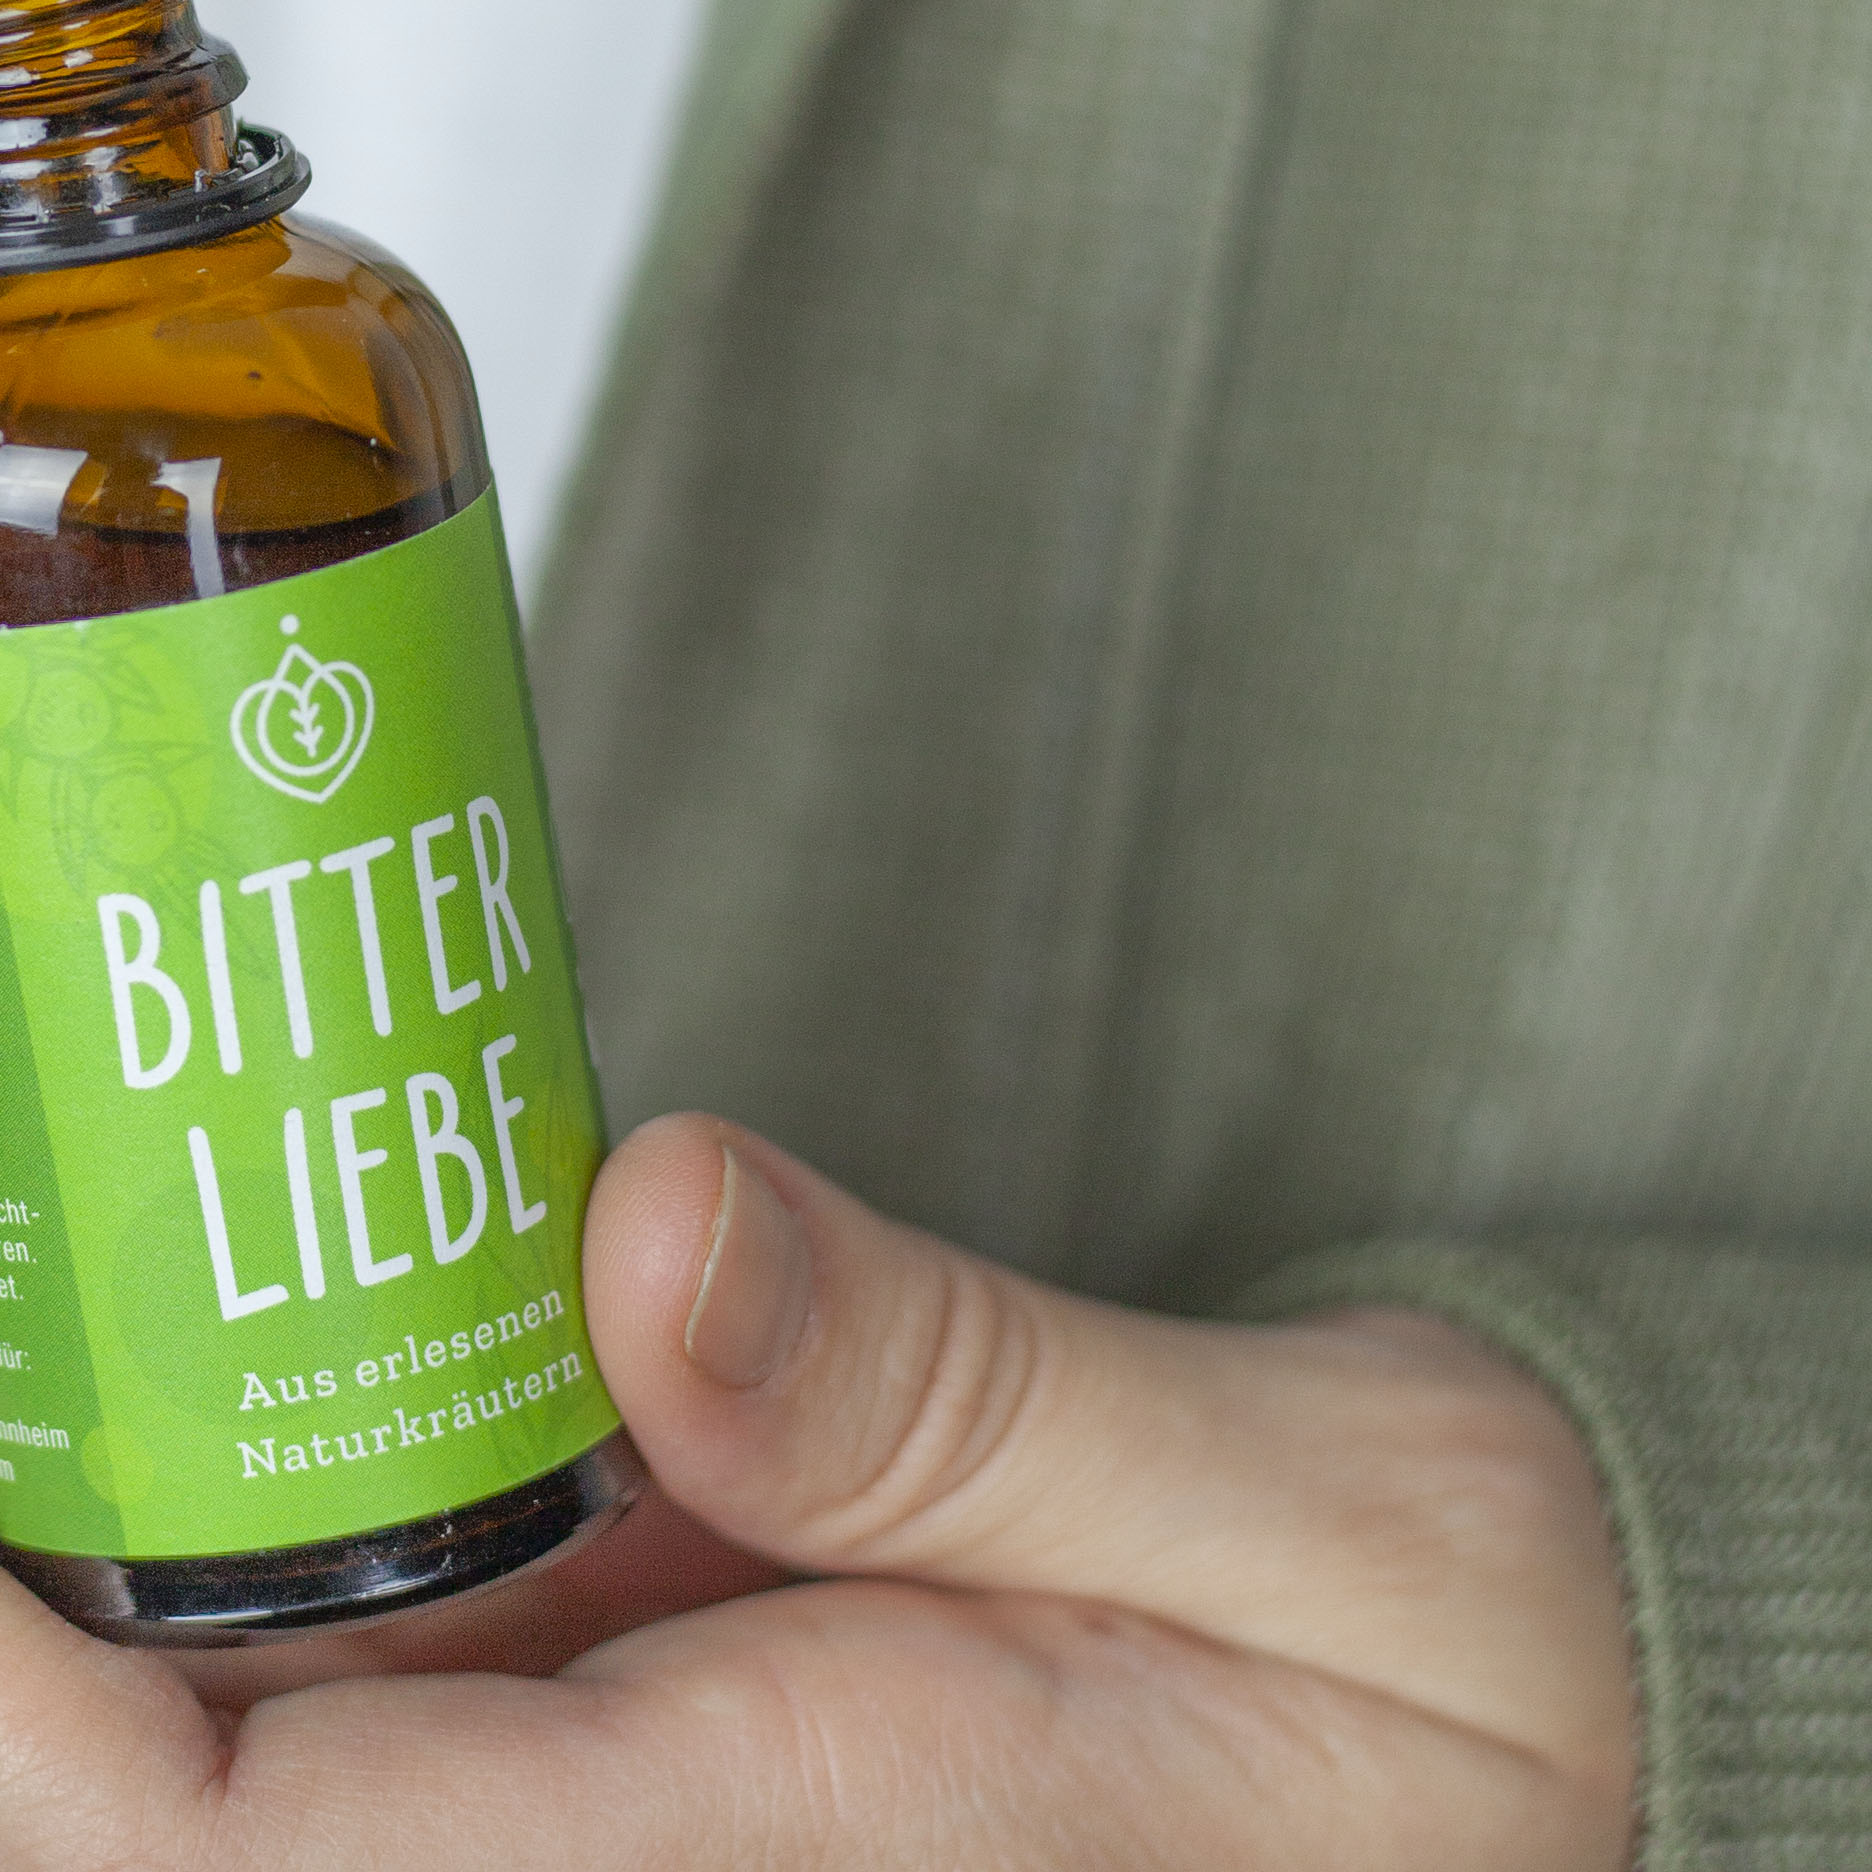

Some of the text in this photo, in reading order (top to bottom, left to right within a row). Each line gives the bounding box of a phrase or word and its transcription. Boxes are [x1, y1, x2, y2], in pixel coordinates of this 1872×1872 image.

[97, 795, 531, 1090] BITTER
[187, 1033, 547, 1322] LIEBE
[237, 1350, 583, 1479] Naturkräutern
[238, 1288, 566, 1411] Aus erlesenen
